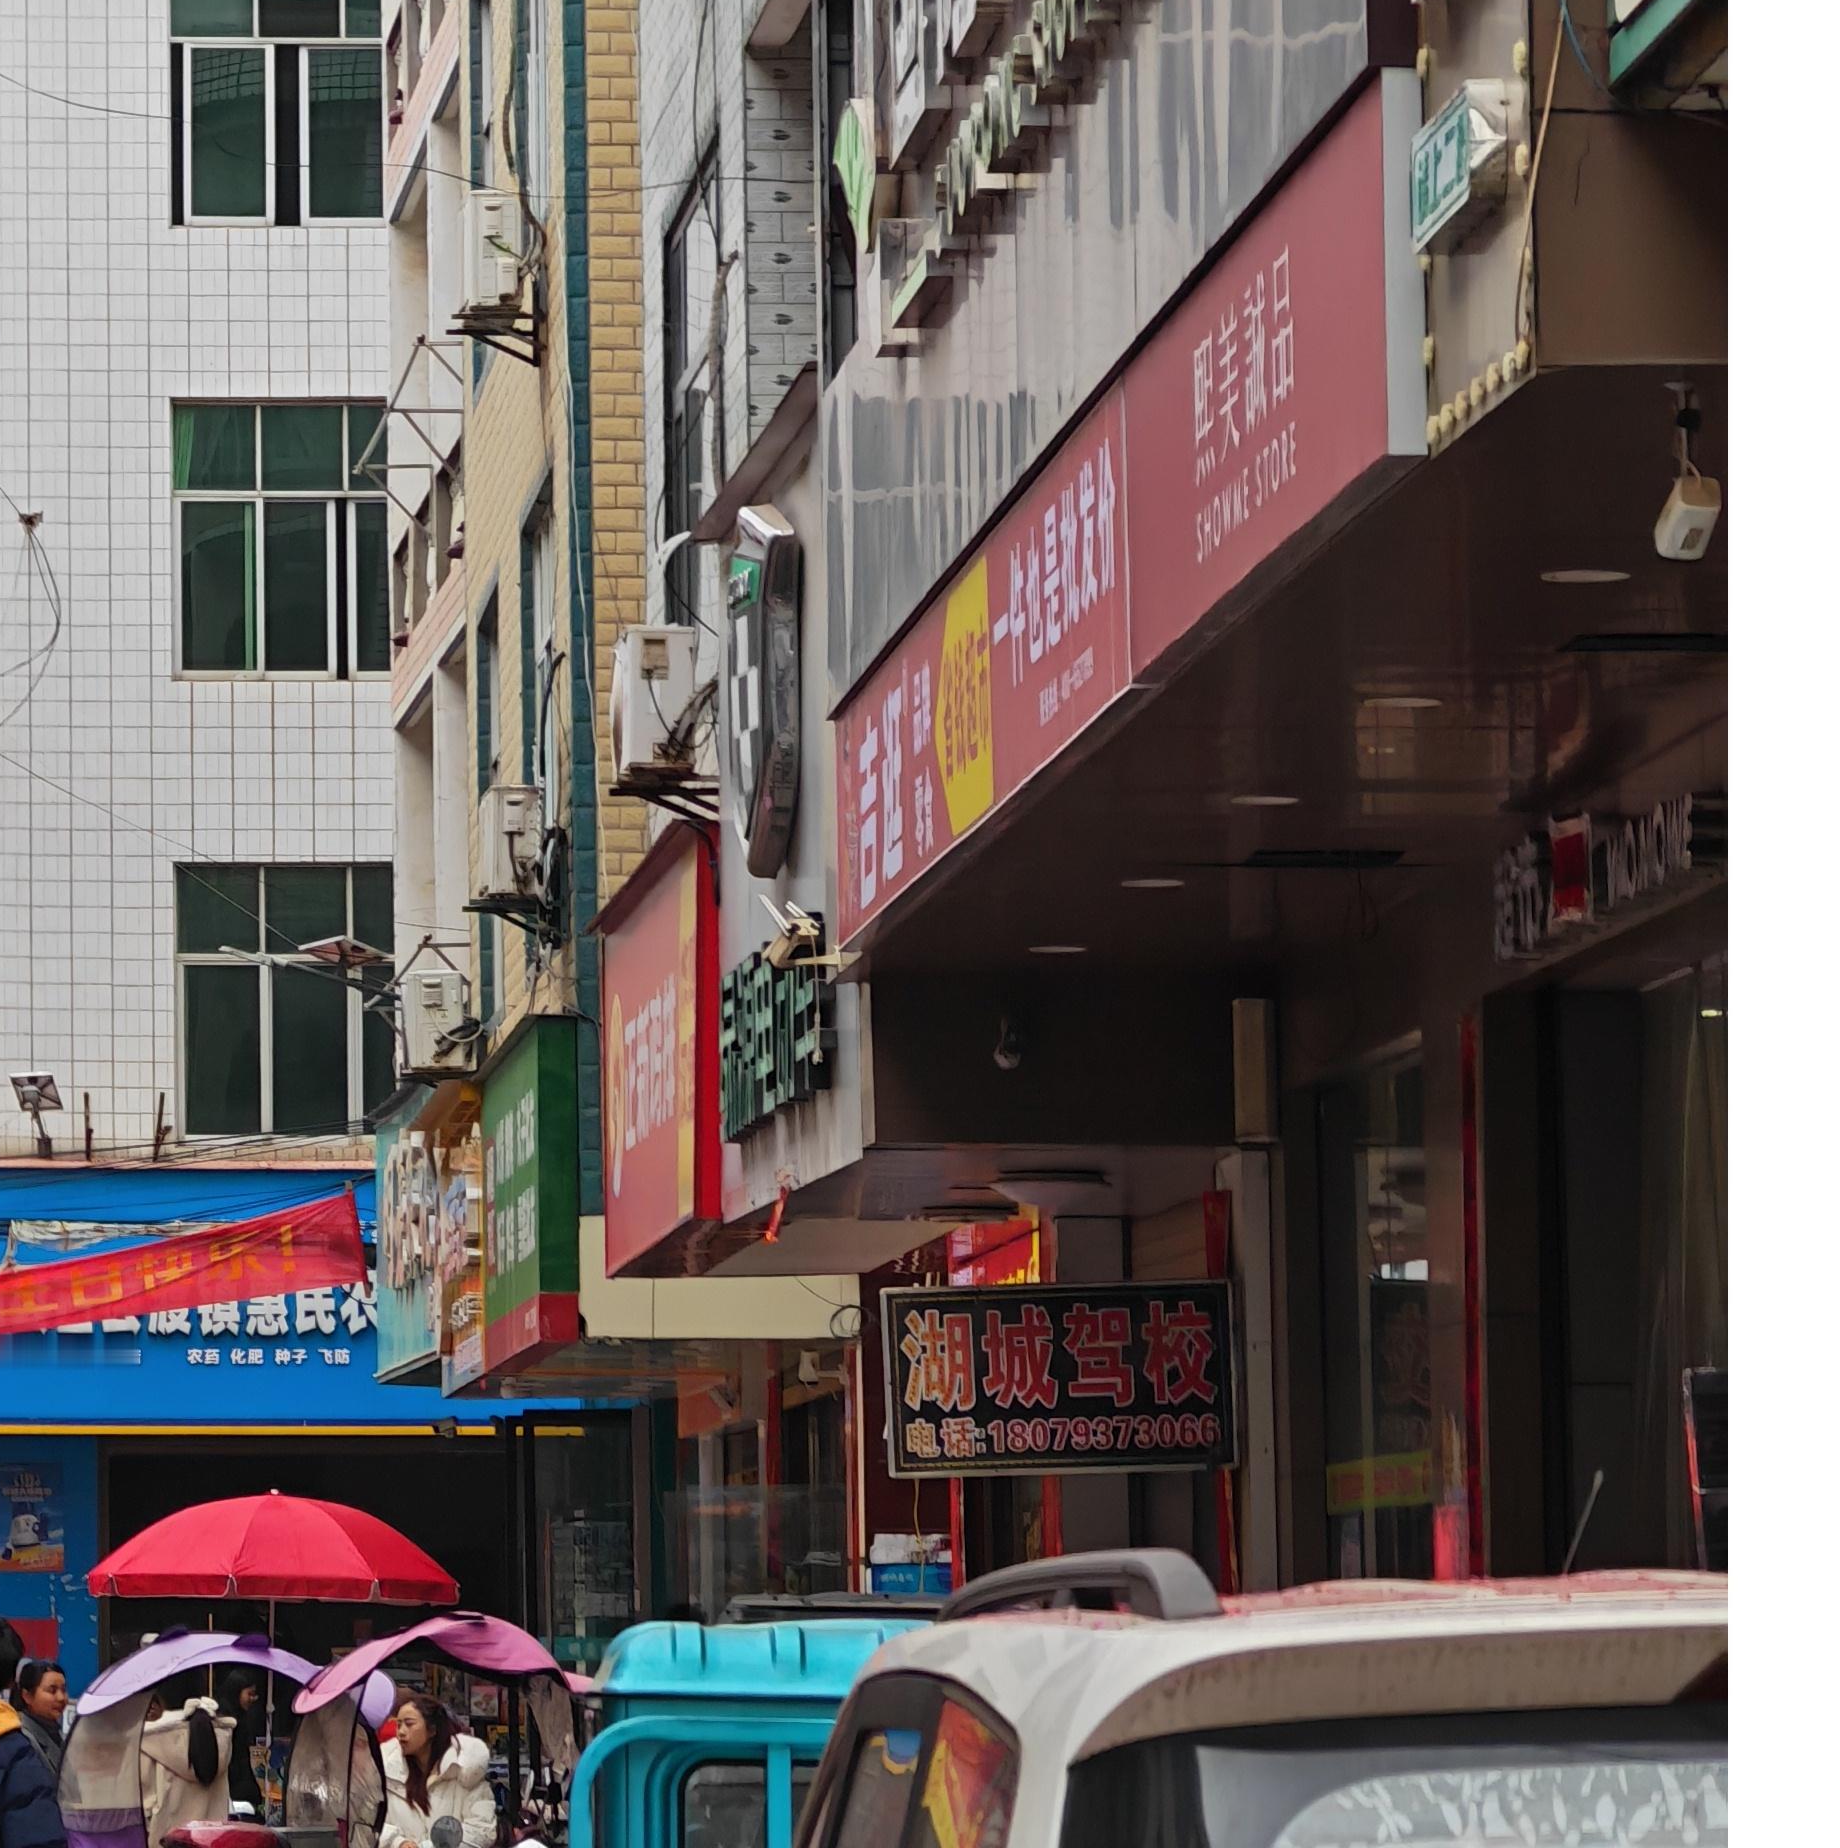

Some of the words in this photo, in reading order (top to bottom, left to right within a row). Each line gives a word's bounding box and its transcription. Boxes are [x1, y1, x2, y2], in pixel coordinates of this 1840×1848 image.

[1195, 474, 1252, 565] SHOWME
[1253, 421, 1297, 510] STORE
[992, 435, 1119, 688] 一件也是批发价
[187, 1348, 220, 1365] 农药
[230, 1348, 264, 1365] 化肥
[274, 1348, 308, 1365] 种子
[317, 1348, 351, 1365] 飞防
[900, 1301, 1217, 1412] 湖城驾校
